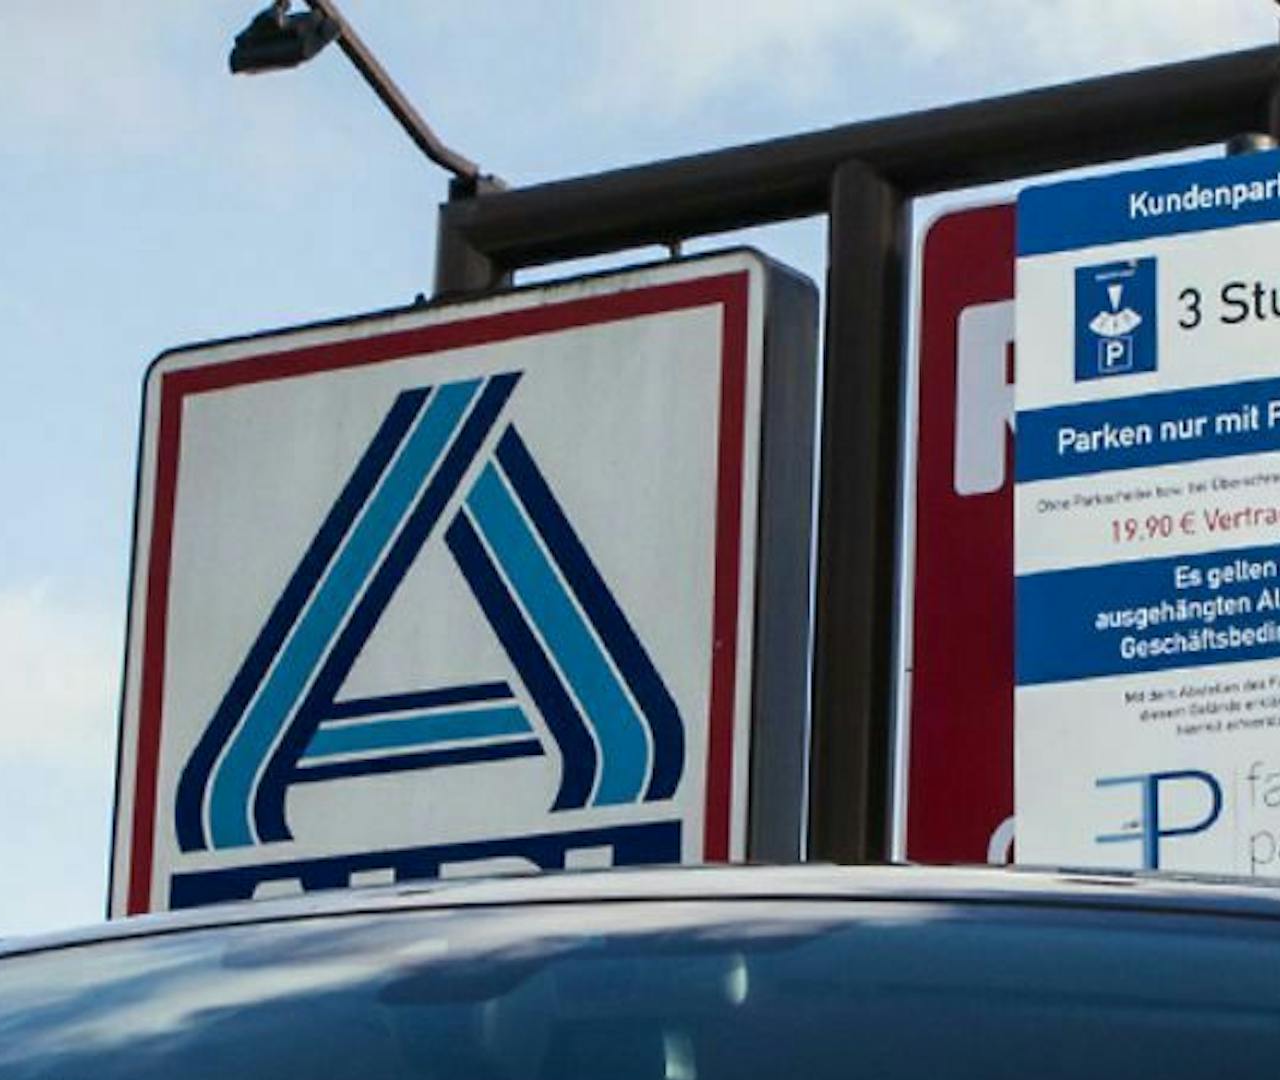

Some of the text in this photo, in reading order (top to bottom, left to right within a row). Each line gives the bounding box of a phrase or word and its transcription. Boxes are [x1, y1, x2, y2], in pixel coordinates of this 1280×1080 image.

[1177, 288, 1203, 330] 3
[1058, 424, 1152, 454] Parken
[1160, 416, 1208, 442] nur
[1215, 404, 1260, 434] mit
[1111, 518, 1174, 545] 19.90
[1179, 512, 1197, 536] €
[1175, 565, 1203, 590] Es
[1207, 558, 1278, 590] gelten
[1095, 592, 1252, 631] ausgehängten
